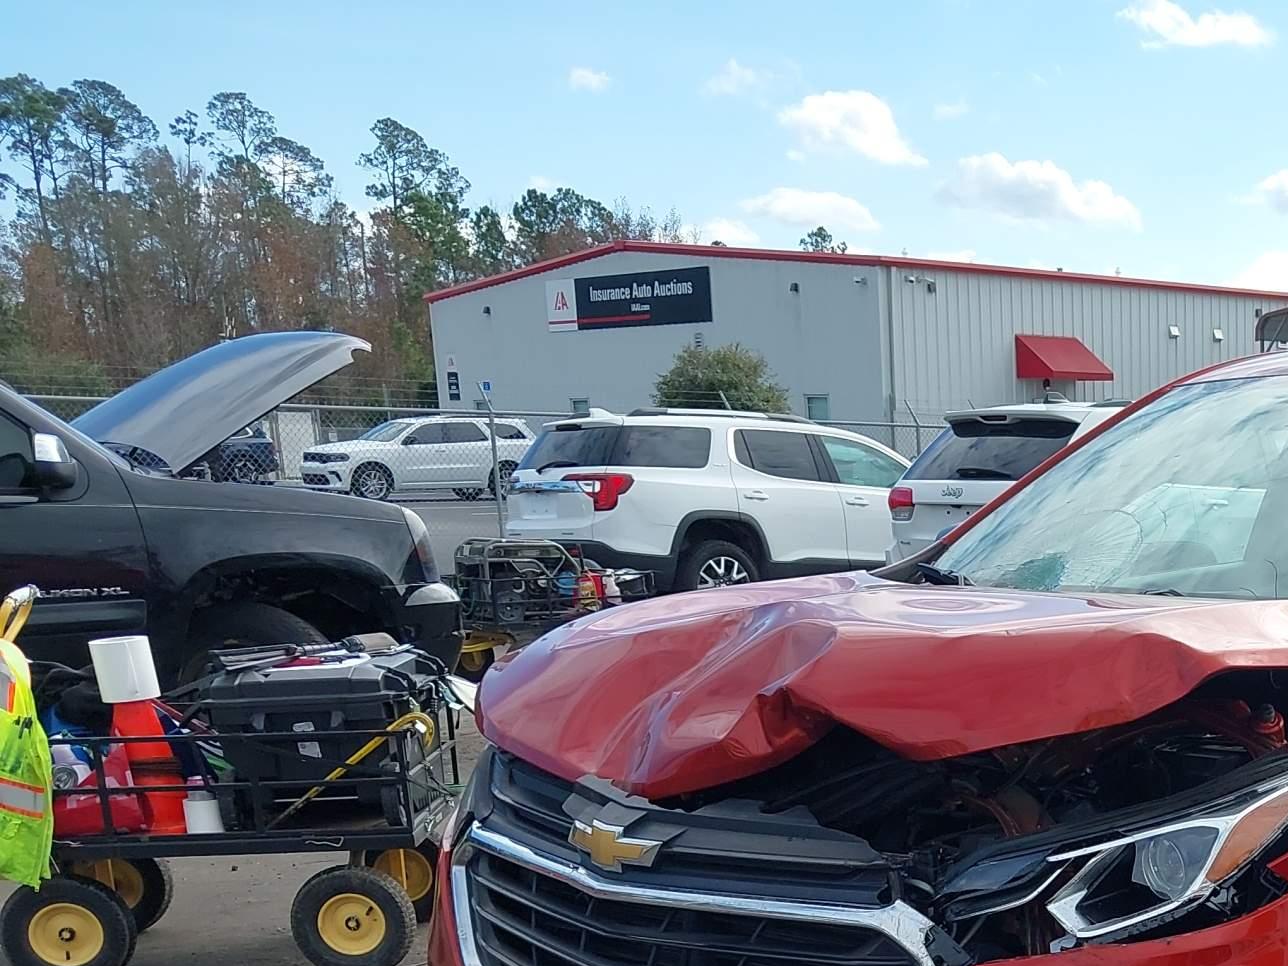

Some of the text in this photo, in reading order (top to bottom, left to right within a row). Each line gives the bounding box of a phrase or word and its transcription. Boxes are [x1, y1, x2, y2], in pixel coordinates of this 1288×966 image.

[589, 279, 693, 302] Insurance Auto Auctions
[101, 586, 130, 597] XL
